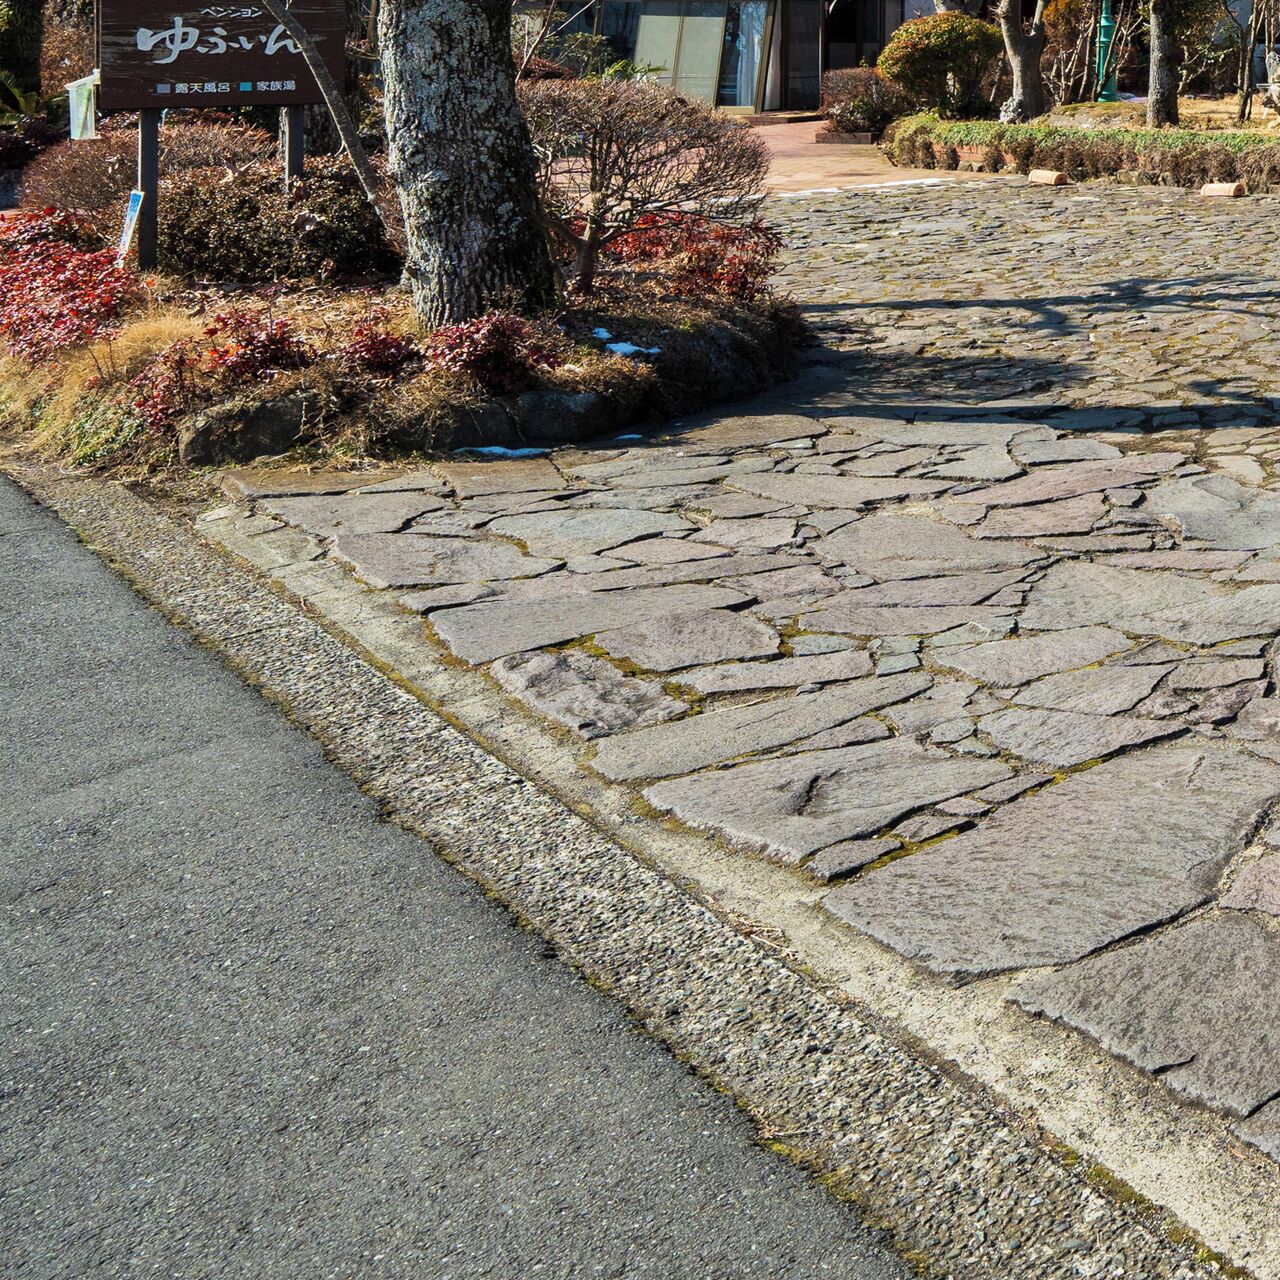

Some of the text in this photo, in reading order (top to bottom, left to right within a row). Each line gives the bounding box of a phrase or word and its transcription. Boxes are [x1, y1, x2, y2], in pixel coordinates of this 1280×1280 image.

[200, 6, 263, 18] ペンション
[136, 16, 303, 64] ゆふいん
[174, 80, 296, 94] 露天風呂 家族湯
